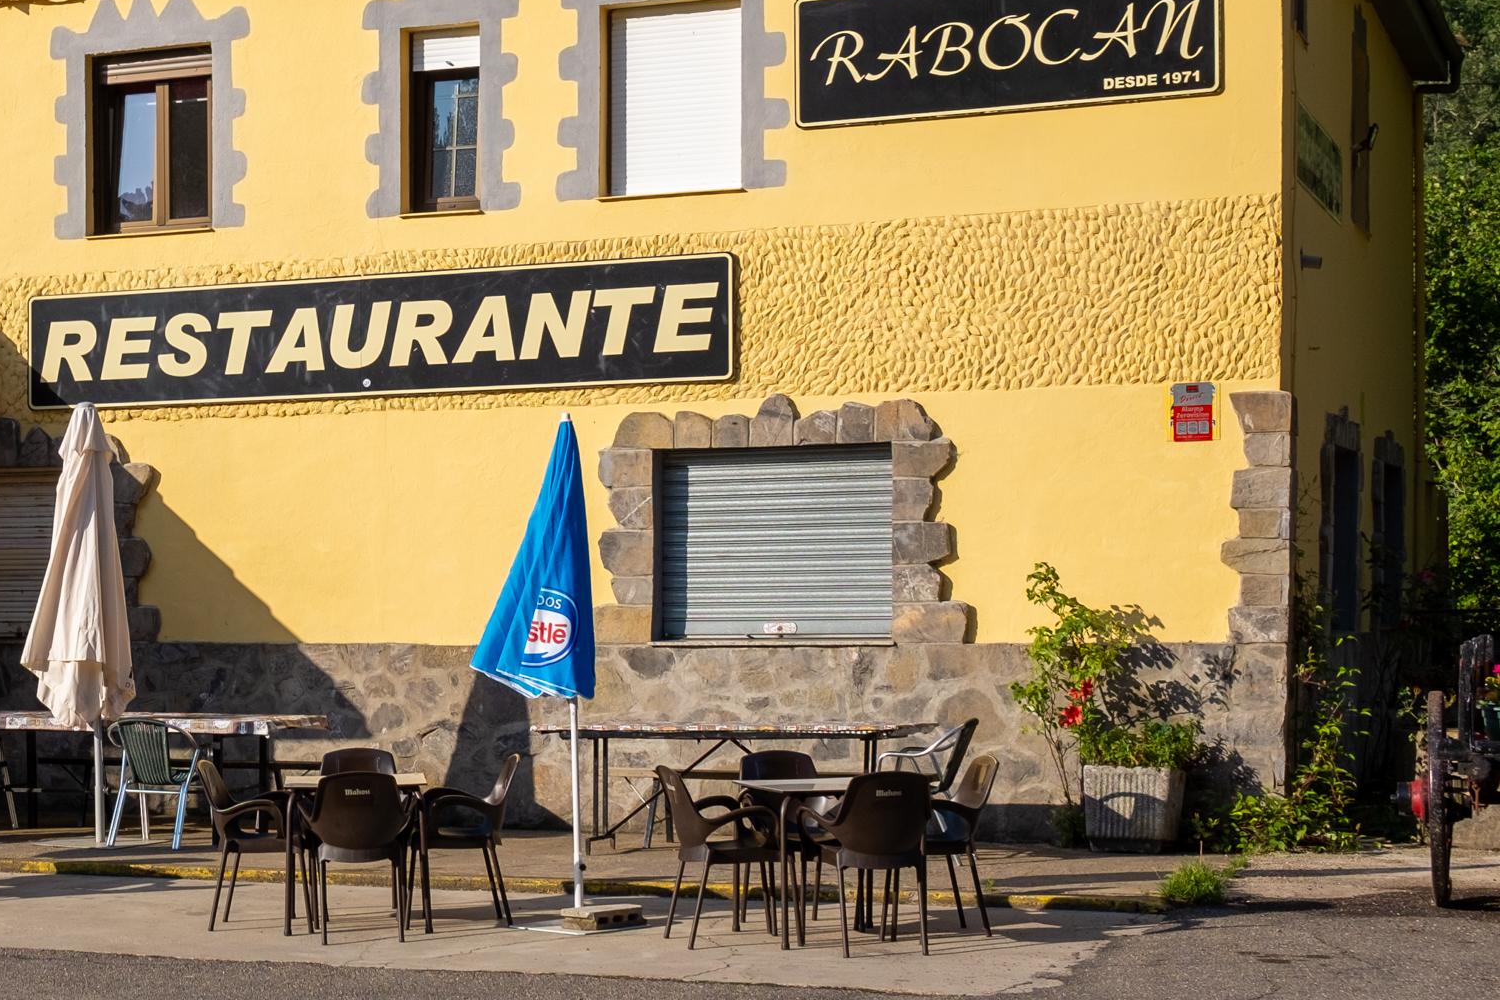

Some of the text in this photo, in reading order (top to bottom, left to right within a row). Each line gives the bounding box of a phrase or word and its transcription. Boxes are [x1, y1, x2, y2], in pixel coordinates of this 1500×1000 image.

[1102, 69, 1200, 90] DESDE 1971
[40, 281, 720, 384] RESTAURANTE
